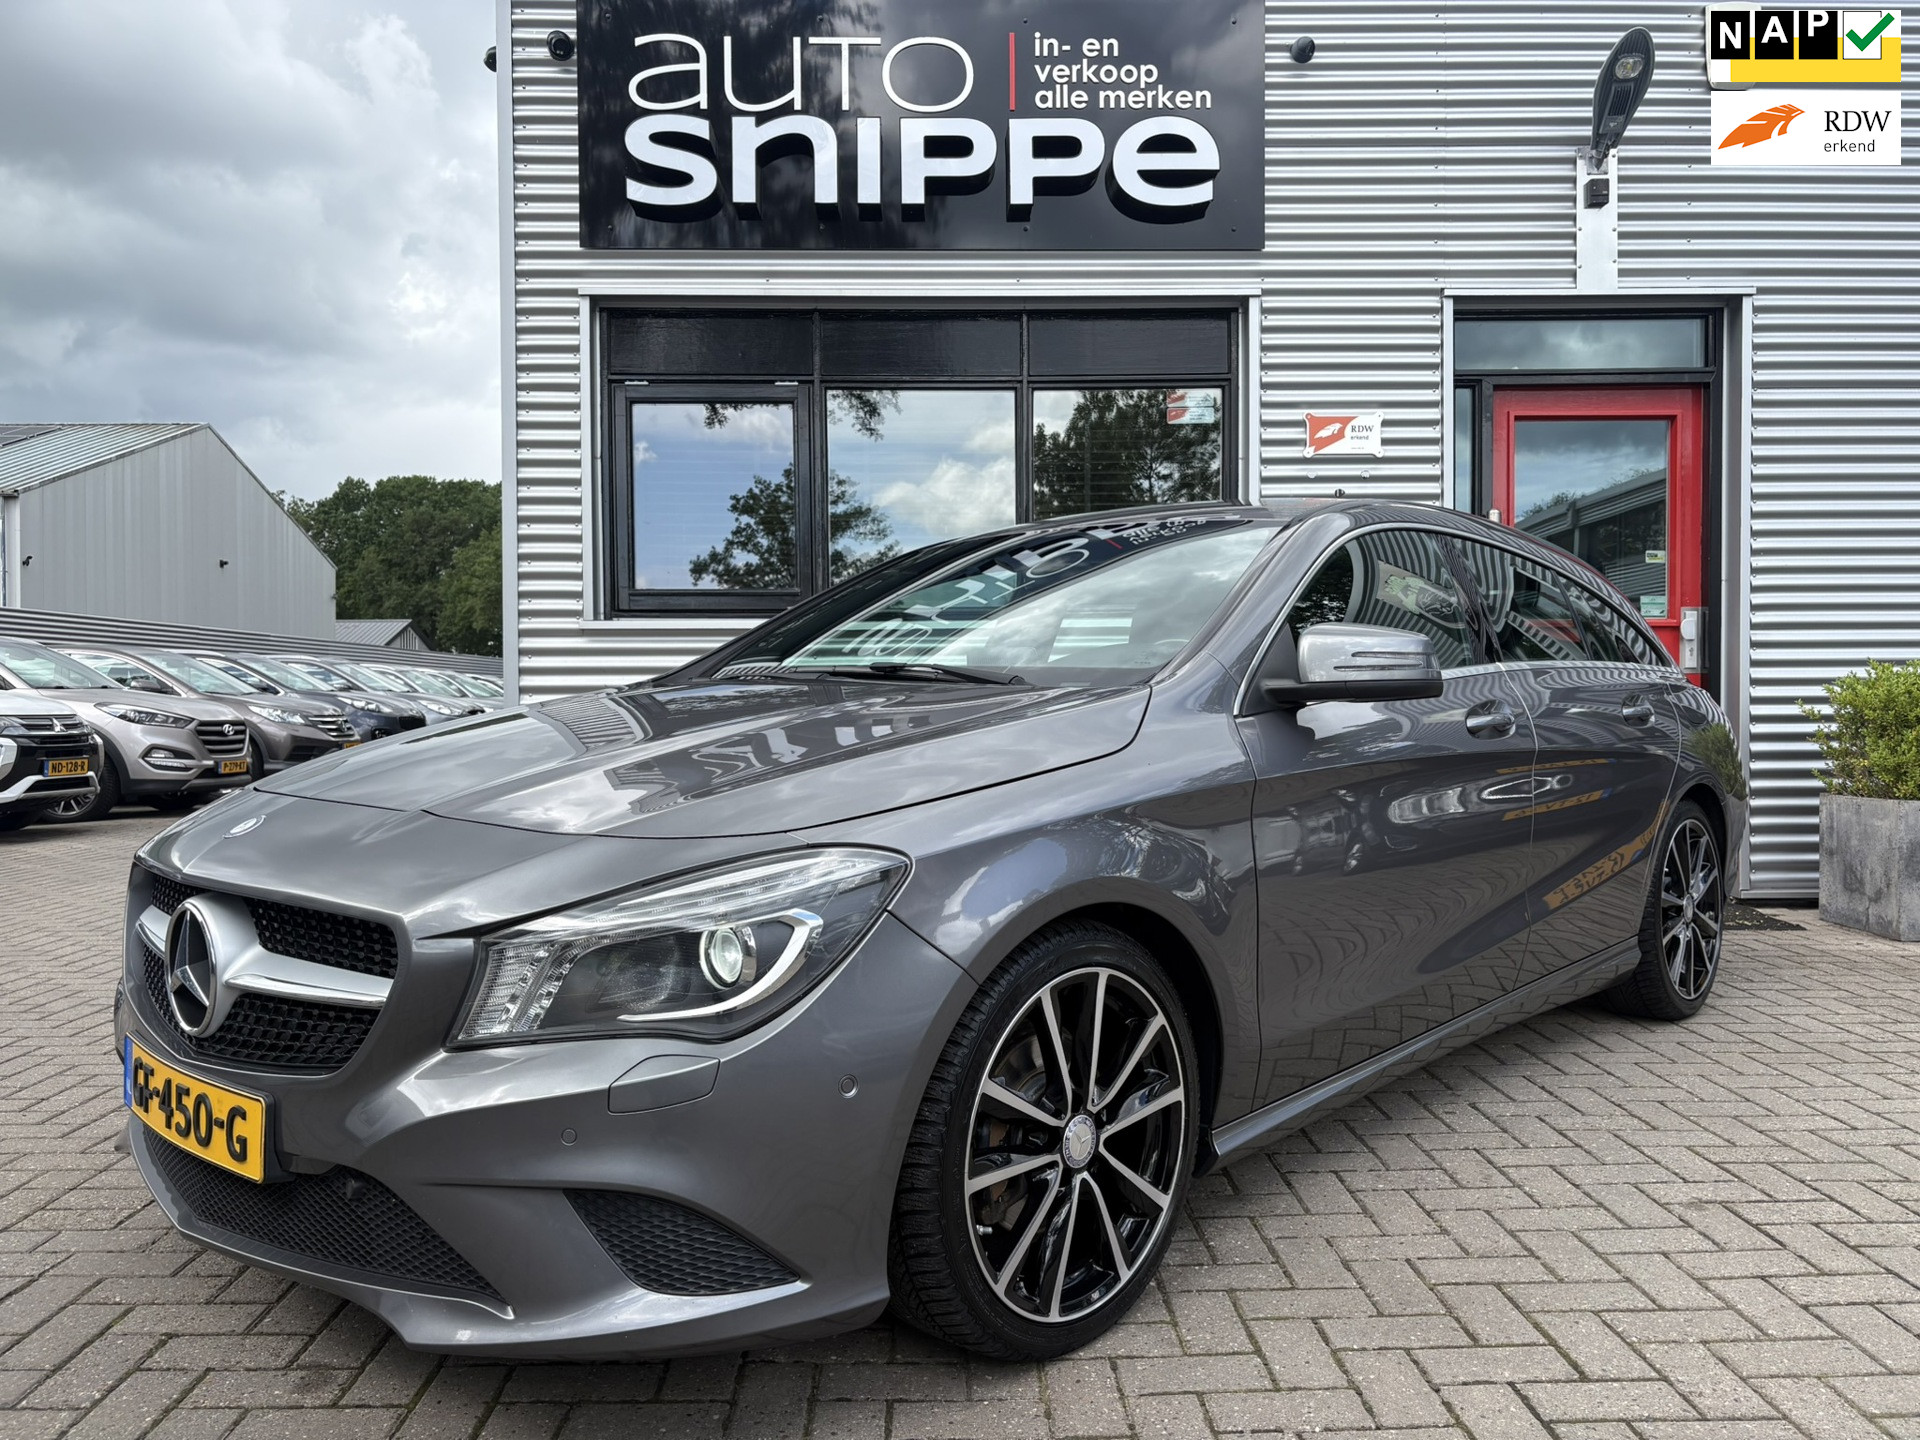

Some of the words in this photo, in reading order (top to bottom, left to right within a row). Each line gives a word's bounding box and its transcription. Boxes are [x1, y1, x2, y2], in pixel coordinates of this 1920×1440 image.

[1033, 32, 1071, 58] in-
[1083, 37, 1119, 58] en
[1034, 58, 1159, 89] verkoop
[1034, 84, 1089, 109] alle
[1099, 84, 1212, 109] merken
[51, 761, 86, 774] ND-128-R
[133, 1056, 248, 1162] GF-450-G
